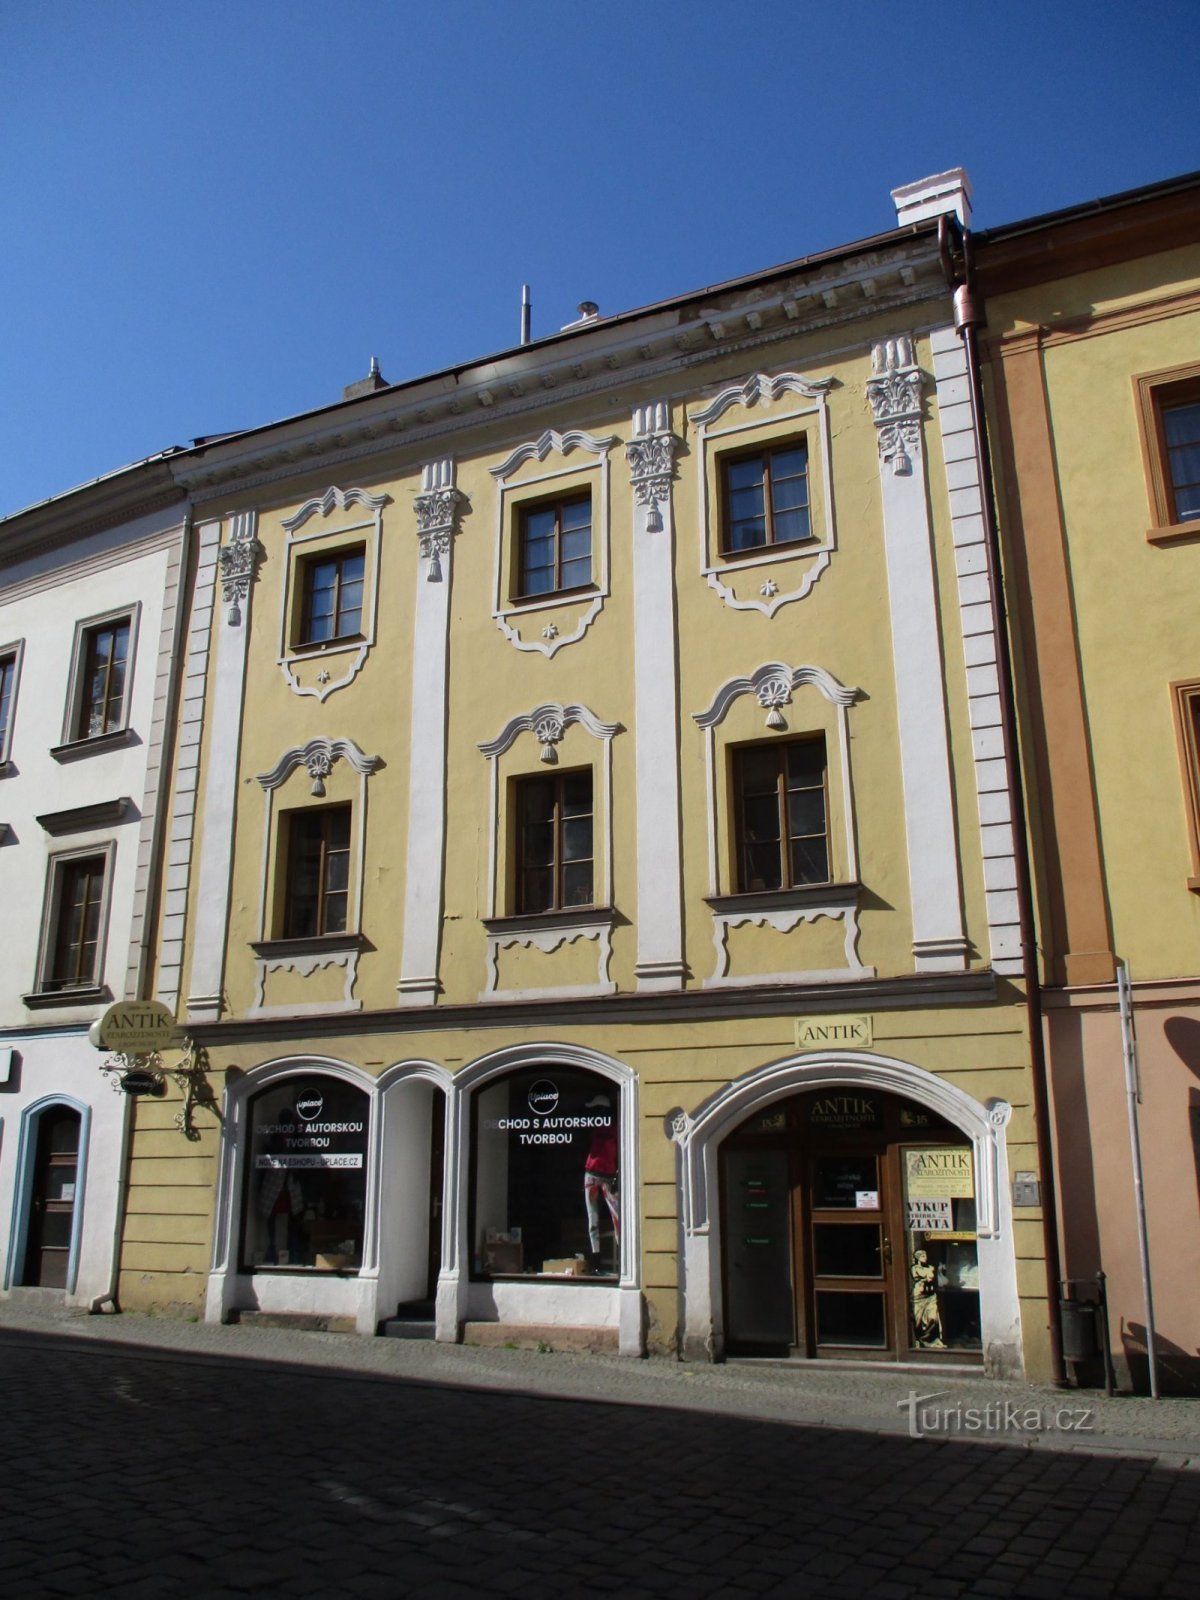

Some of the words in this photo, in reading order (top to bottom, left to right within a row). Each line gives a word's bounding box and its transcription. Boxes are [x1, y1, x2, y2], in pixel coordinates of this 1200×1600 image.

[106, 1014, 169, 1029] ANTIK
[803, 1025, 863, 1041] ANTIK
[811, 1097, 875, 1114] ANTIK
[256, 1123, 296, 1134] OBCHOD
[297, 1123, 304, 1133] S
[305, 1121, 363, 1133] AUTORSKOU
[483, 1118, 530, 1129] OBCHOD
[533, 1118, 540, 1129] S
[542, 1116, 612, 1128] AUTORSKOU
[286, 1137, 331, 1148] TVORBOU
[519, 1133, 573, 1145] TVORBOU
[320, 1157, 359, 1166] UPLACE.CZ
[917, 1154, 970, 1168] ANTIK
[908, 1219, 950, 1229] ZLATA
